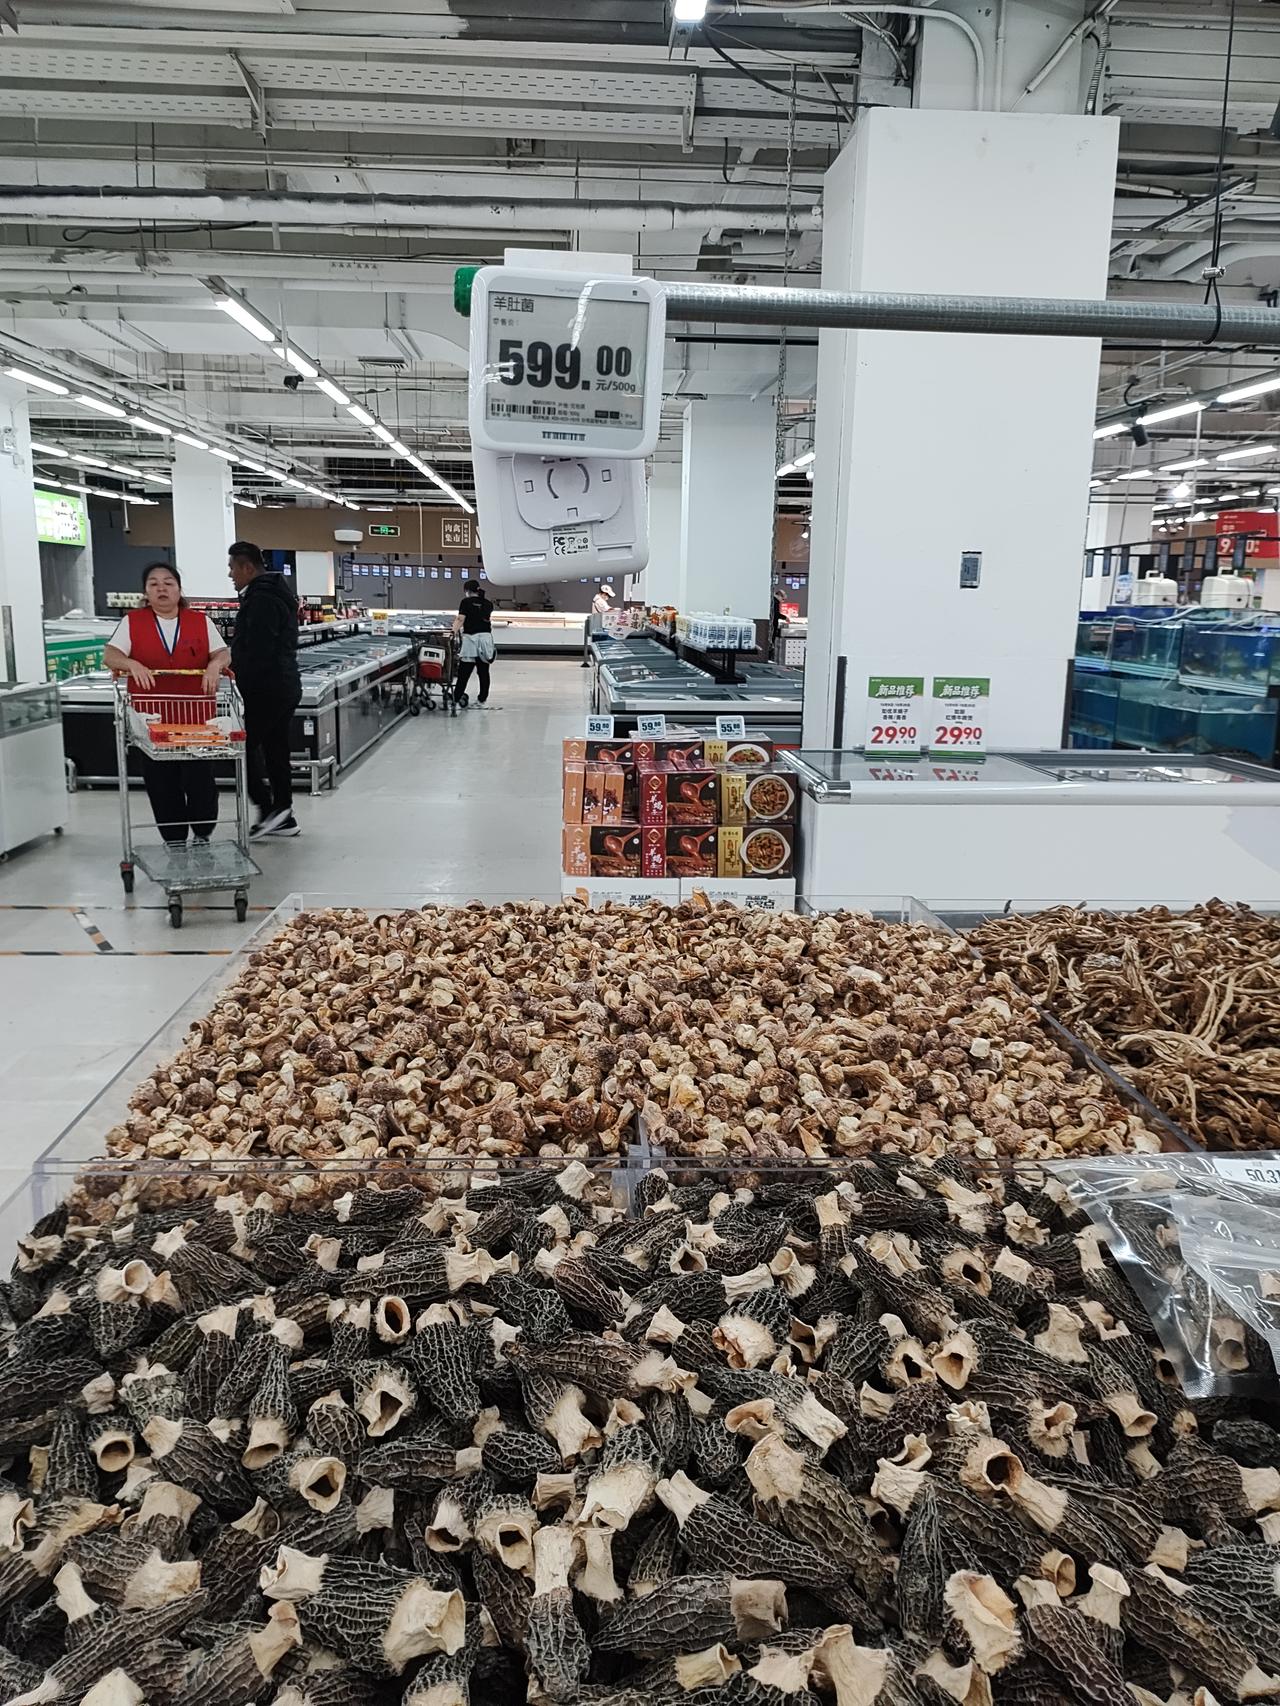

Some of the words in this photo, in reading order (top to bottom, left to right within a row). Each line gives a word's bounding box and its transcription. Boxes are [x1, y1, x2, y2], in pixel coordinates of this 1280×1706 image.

[493, 296, 534, 313] 羊肚菌
[498, 339, 632, 390] 599.00
[596, 380, 636, 393] 元/500g
[875, 684, 916, 698] 新品推荐
[939, 684, 981, 699] 新品推荐
